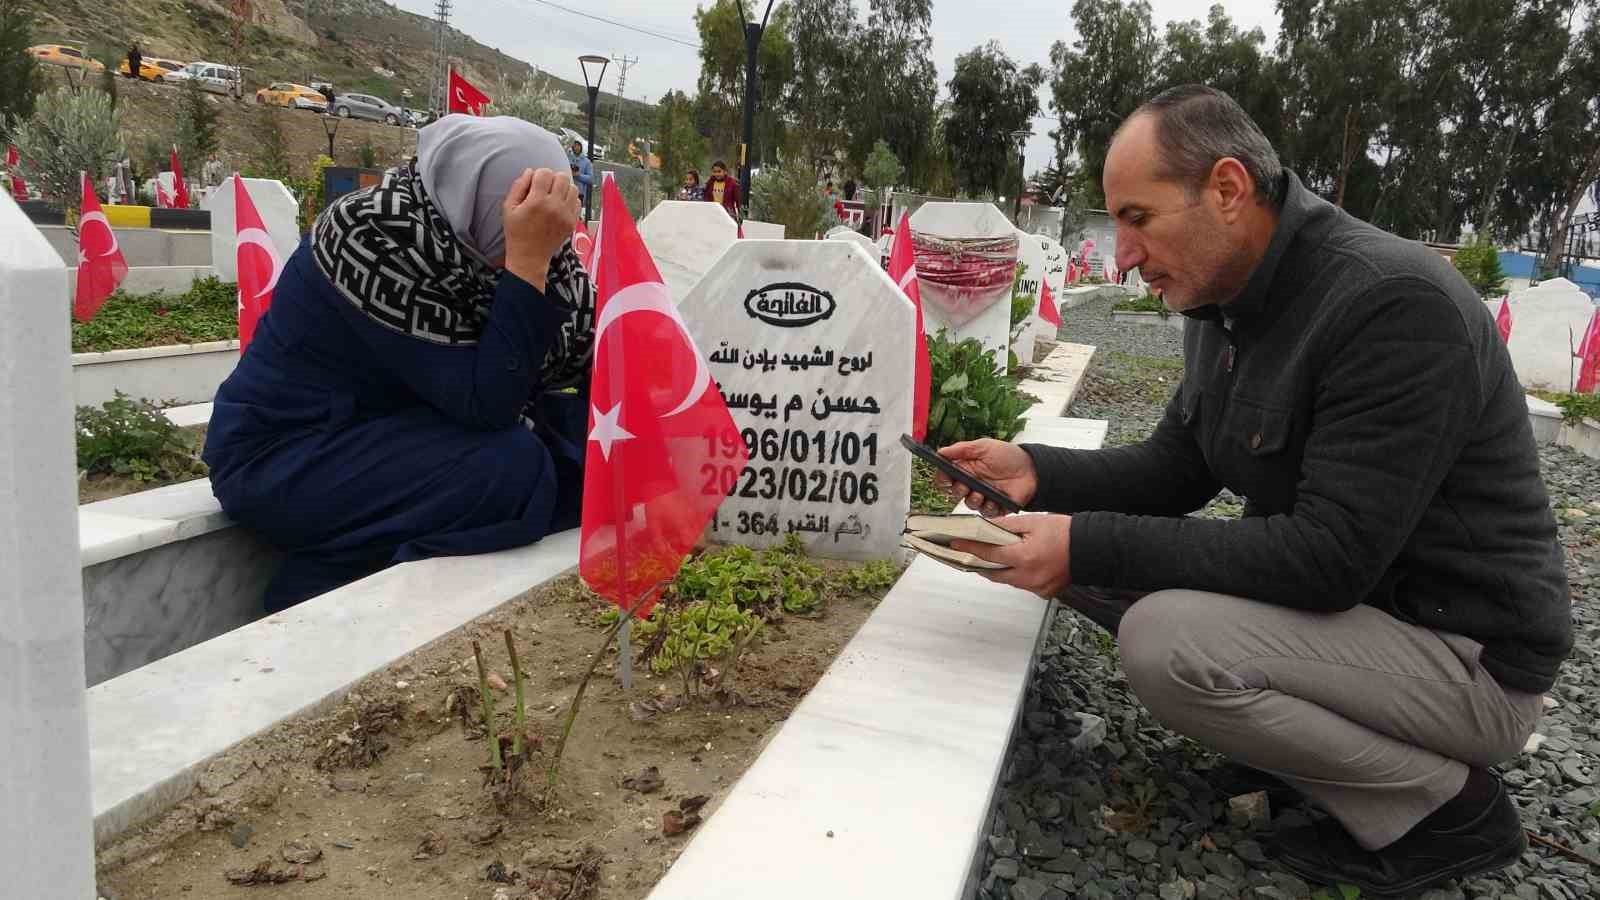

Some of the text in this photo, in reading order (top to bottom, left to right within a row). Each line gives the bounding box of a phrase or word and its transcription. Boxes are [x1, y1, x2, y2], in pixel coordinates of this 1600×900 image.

[757, 291, 821, 317] الفاتحة
[781, 345, 834, 370] الشهيد
[838, 351, 873, 376] لروح
[811, 388, 880, 420] حسن
[702, 427, 878, 466] 1996/01/01
[700, 463, 879, 505] 2023/02/06
[736, 510, 780, 536] 364
